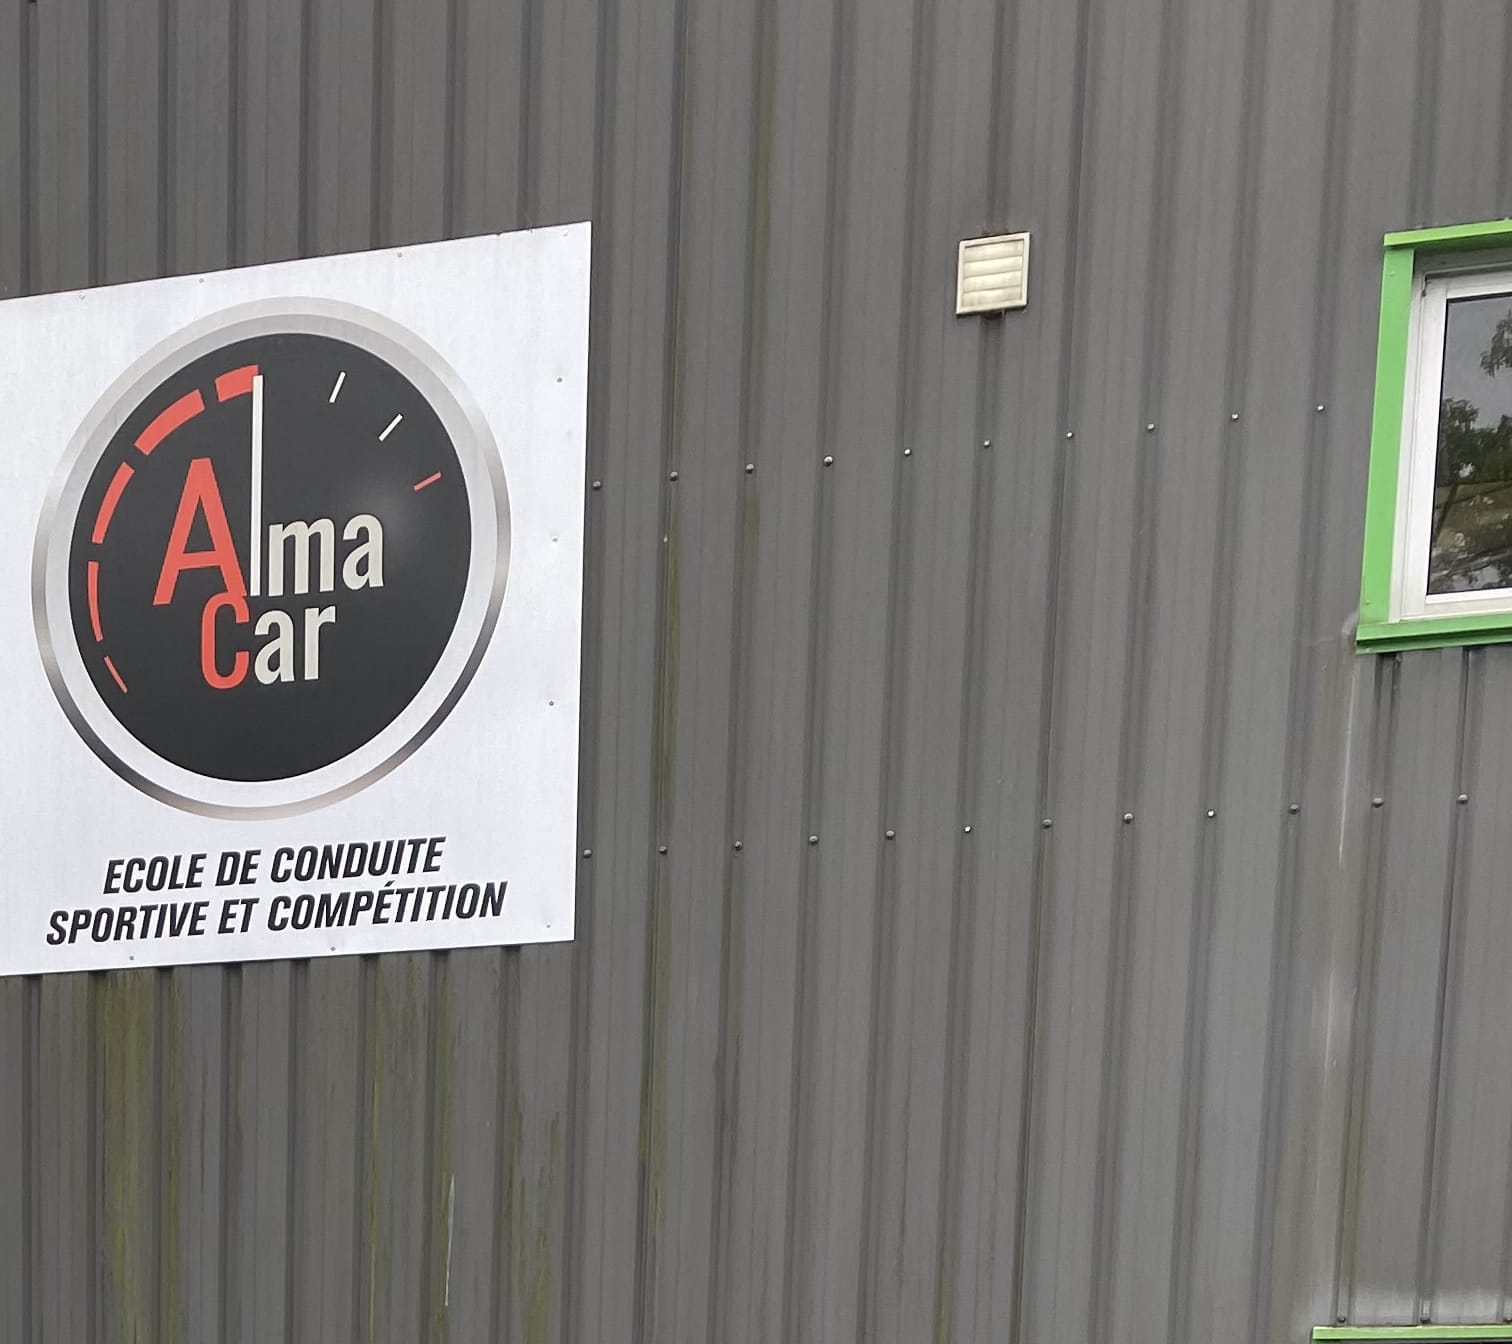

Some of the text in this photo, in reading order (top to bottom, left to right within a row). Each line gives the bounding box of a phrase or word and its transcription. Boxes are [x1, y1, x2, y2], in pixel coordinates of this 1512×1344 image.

[152, 375, 384, 606] Alma
[200, 593, 336, 690] Car
[102, 836, 447, 895] ECOLE DE CONDUITE
[46, 880, 508, 946] SPORTIVE ET COMPÉTITION
